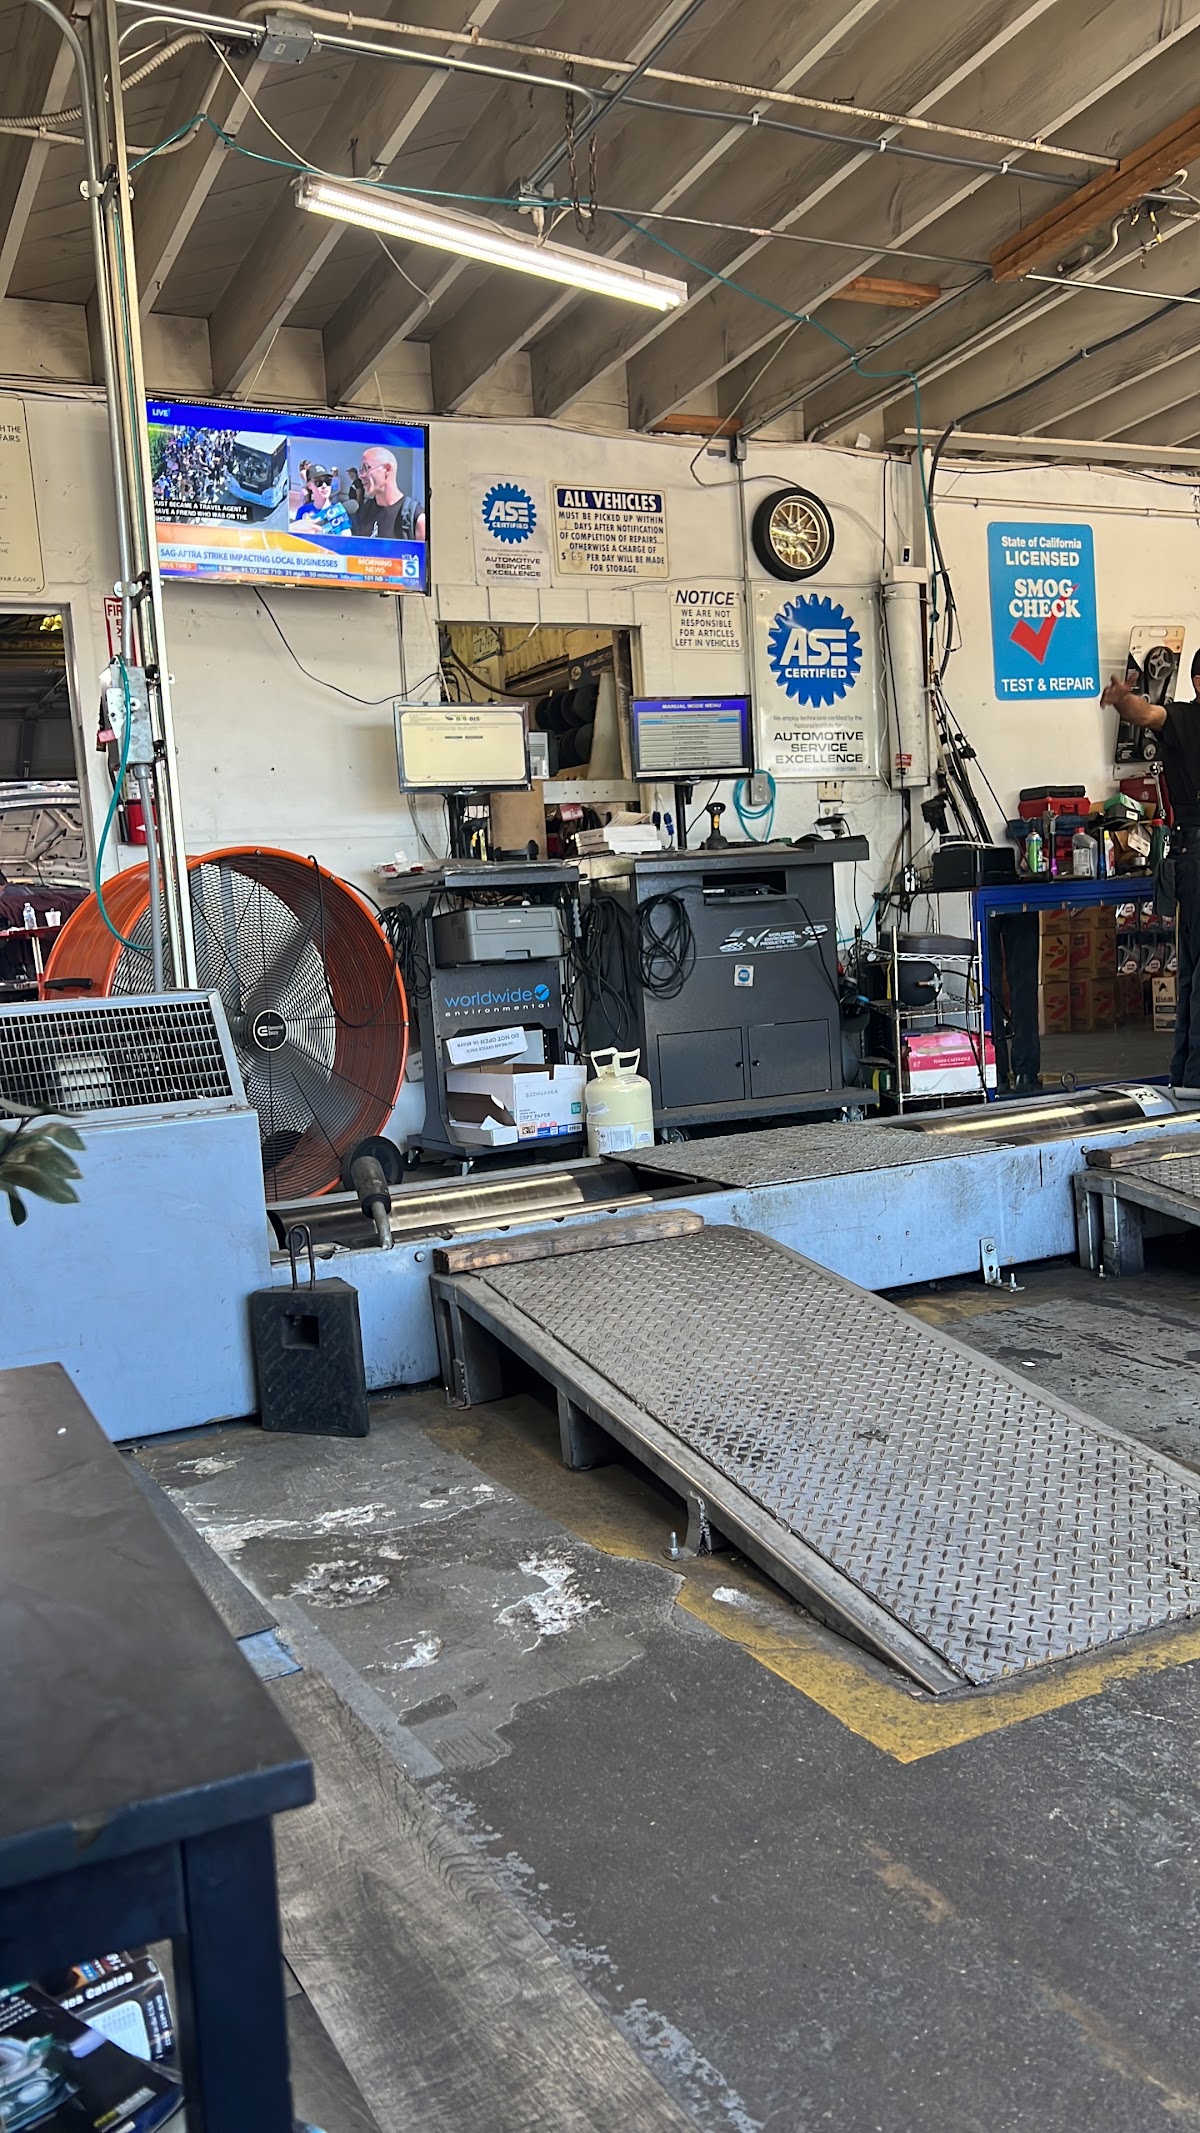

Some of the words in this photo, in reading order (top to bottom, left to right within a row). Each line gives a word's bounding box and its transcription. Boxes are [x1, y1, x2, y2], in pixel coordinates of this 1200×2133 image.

[152, 408, 169, 417] LIVE
[7, 425, 22, 433] THE
[169, 501, 192, 509] BECAME
[200, 503, 221, 511] TRAVEL
[563, 490, 589, 508] ALL
[592, 492, 657, 512] VEHICLES
[176, 509, 196, 517] FRIEND
[489, 500, 529, 522] ASE
[558, 511, 579, 519] MUST
[594, 513, 621, 521] PICKED
[636, 515, 664, 524] WITHIN
[492, 521, 529, 529] CERTIFIED
[574, 522, 592, 530] DAYS
[594, 523, 615, 531] AFTER
[617, 525, 664, 534] NOTIFICATION
[560, 532, 569, 540] OF
[571, 532, 616, 542] COMPLETION
[629, 535, 657, 544] REPAIRS
[1001, 535, 1026, 548] State
[1027, 536, 1038, 548] of
[1039, 536, 1082, 549] California
[569, 543, 610, 552] OTHERWISE
[612, 544, 617, 552] A
[618, 545, 645, 554] CHARGE
[648, 546, 656, 554] OF
[160, 548, 201, 559] SAG-AFTRA
[203, 551, 228, 561] STRIKE
[229, 553, 270, 563] IMPACTING
[272, 556, 295, 565] LOCAL
[297, 556, 338, 567] BUSINESSES
[358, 558, 392, 567] MORNING
[485, 556, 541, 564] AUTOMOTIVE
[586, 553, 599, 562] PER
[601, 554, 615, 562] DAY
[617, 555, 633, 563] WILL
[646, 556, 665, 564] MADE
[1005, 550, 1080, 567] LICENSED
[365, 566, 386, 574] NEWS
[404, 561, 417, 577] 5
[486, 569, 541, 577] EXCELLENCE
[590, 564, 604, 572] FOR
[606, 565, 639, 573] STORAGE.
[1014, 578, 1074, 598] SMOG
[675, 590, 735, 606] NOTICE
[107, 604, 122, 617] FIR
[681, 609, 693, 617] WE
[696, 609, 711, 617] ARE
[715, 610, 730, 618] NOT
[1008, 598, 1082, 618] CHECK
[680, 618, 732, 628] RESPONSIBLE
[679, 628, 695, 637] FOR
[698, 629, 735, 637] ARTICLES
[675, 638, 692, 647] LEFT
[694, 639, 703, 647] IN
[705, 639, 740, 648] VEHICLES
[779, 628, 848, 666] ASE
[784, 667, 848, 679] CERTIFIED
[1001, 678, 1035, 692] TEST
[1037, 678, 1047, 692] &
[1050, 677, 1095, 692] REPAIR
[774, 731, 864, 741] AUTOMOTIVE
[791, 743, 848, 752] SERVICE
[775, 753, 863, 764] EXCELLENCE
[444, 988, 533, 1008] worldwide
[445, 1001, 550, 1018] environmental
[85, 1971, 133, 2000] Catalog
